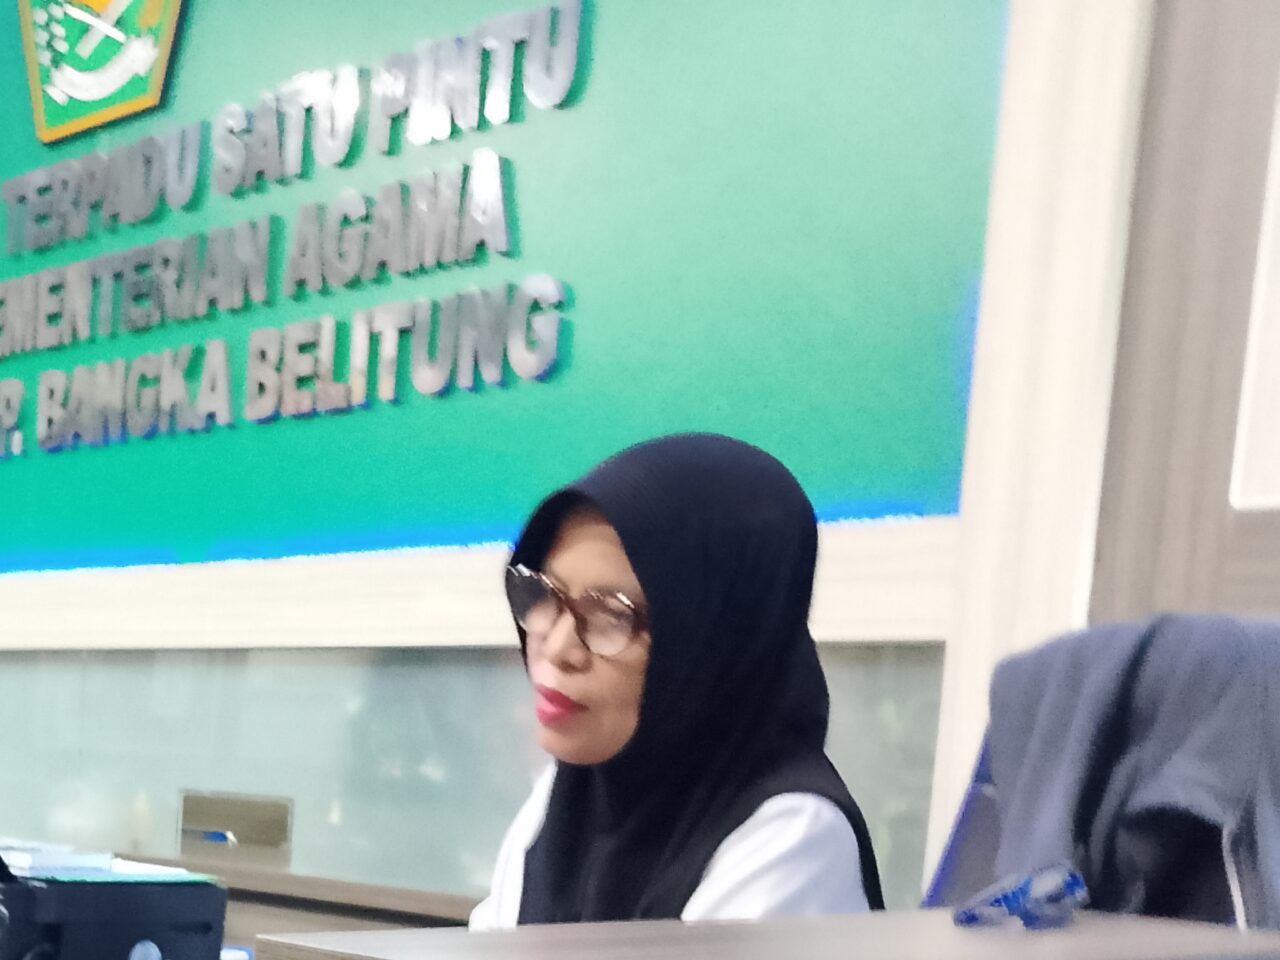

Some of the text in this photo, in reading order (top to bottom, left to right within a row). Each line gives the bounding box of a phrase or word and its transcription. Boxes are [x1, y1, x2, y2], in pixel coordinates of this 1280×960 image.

[1, 120, 204, 256] TERPADU
[212, 64, 361, 198] SATU
[282, 146, 509, 297] AGAMA
[36, 338, 231, 450] BANGKA
[243, 273, 565, 421] BELITUNG
